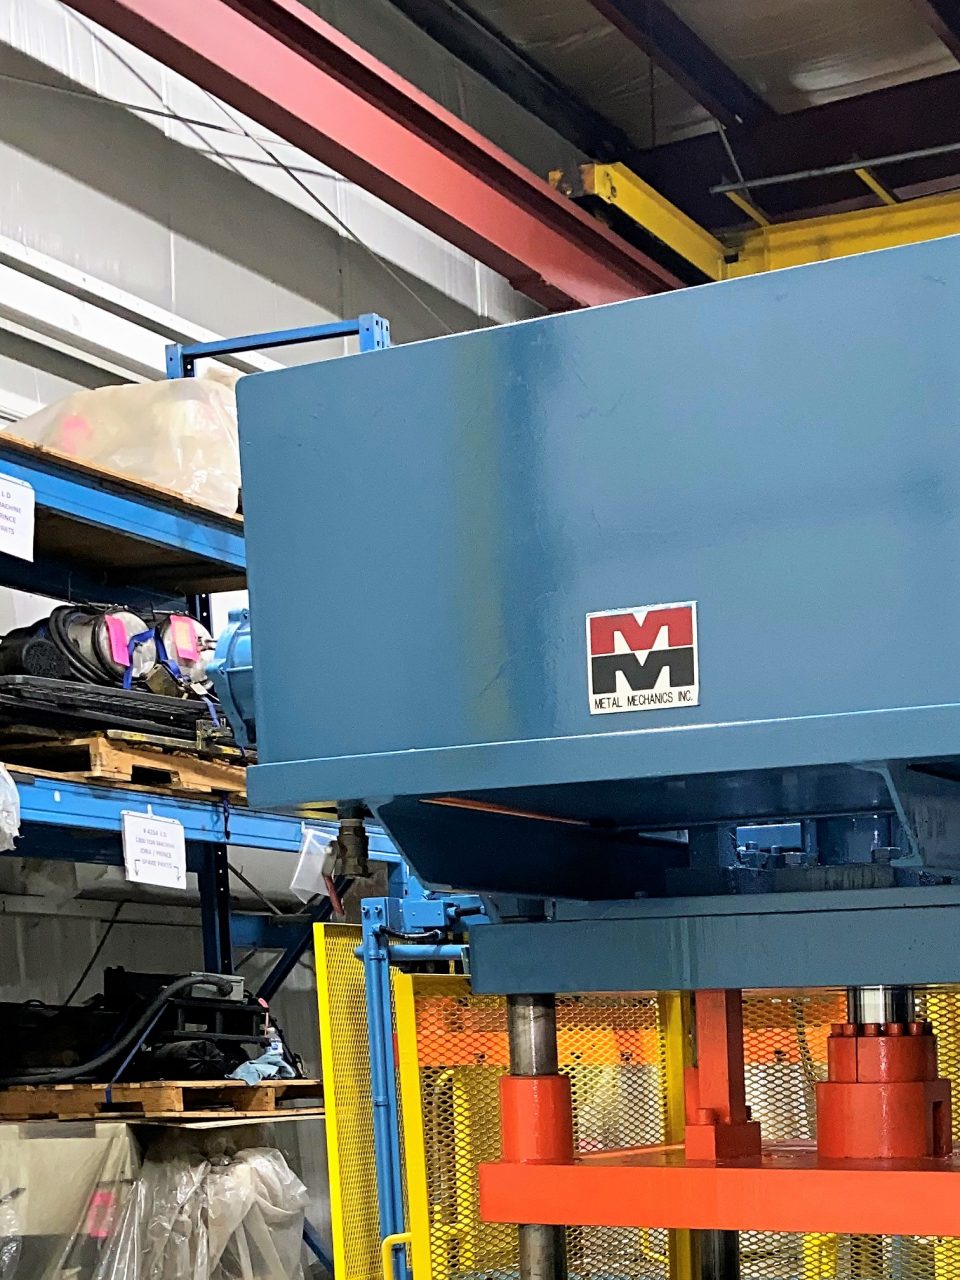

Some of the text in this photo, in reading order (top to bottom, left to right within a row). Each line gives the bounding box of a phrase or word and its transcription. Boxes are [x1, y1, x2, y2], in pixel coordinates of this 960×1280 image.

[594, 690, 694, 710] METAL MECHANICS INC.
